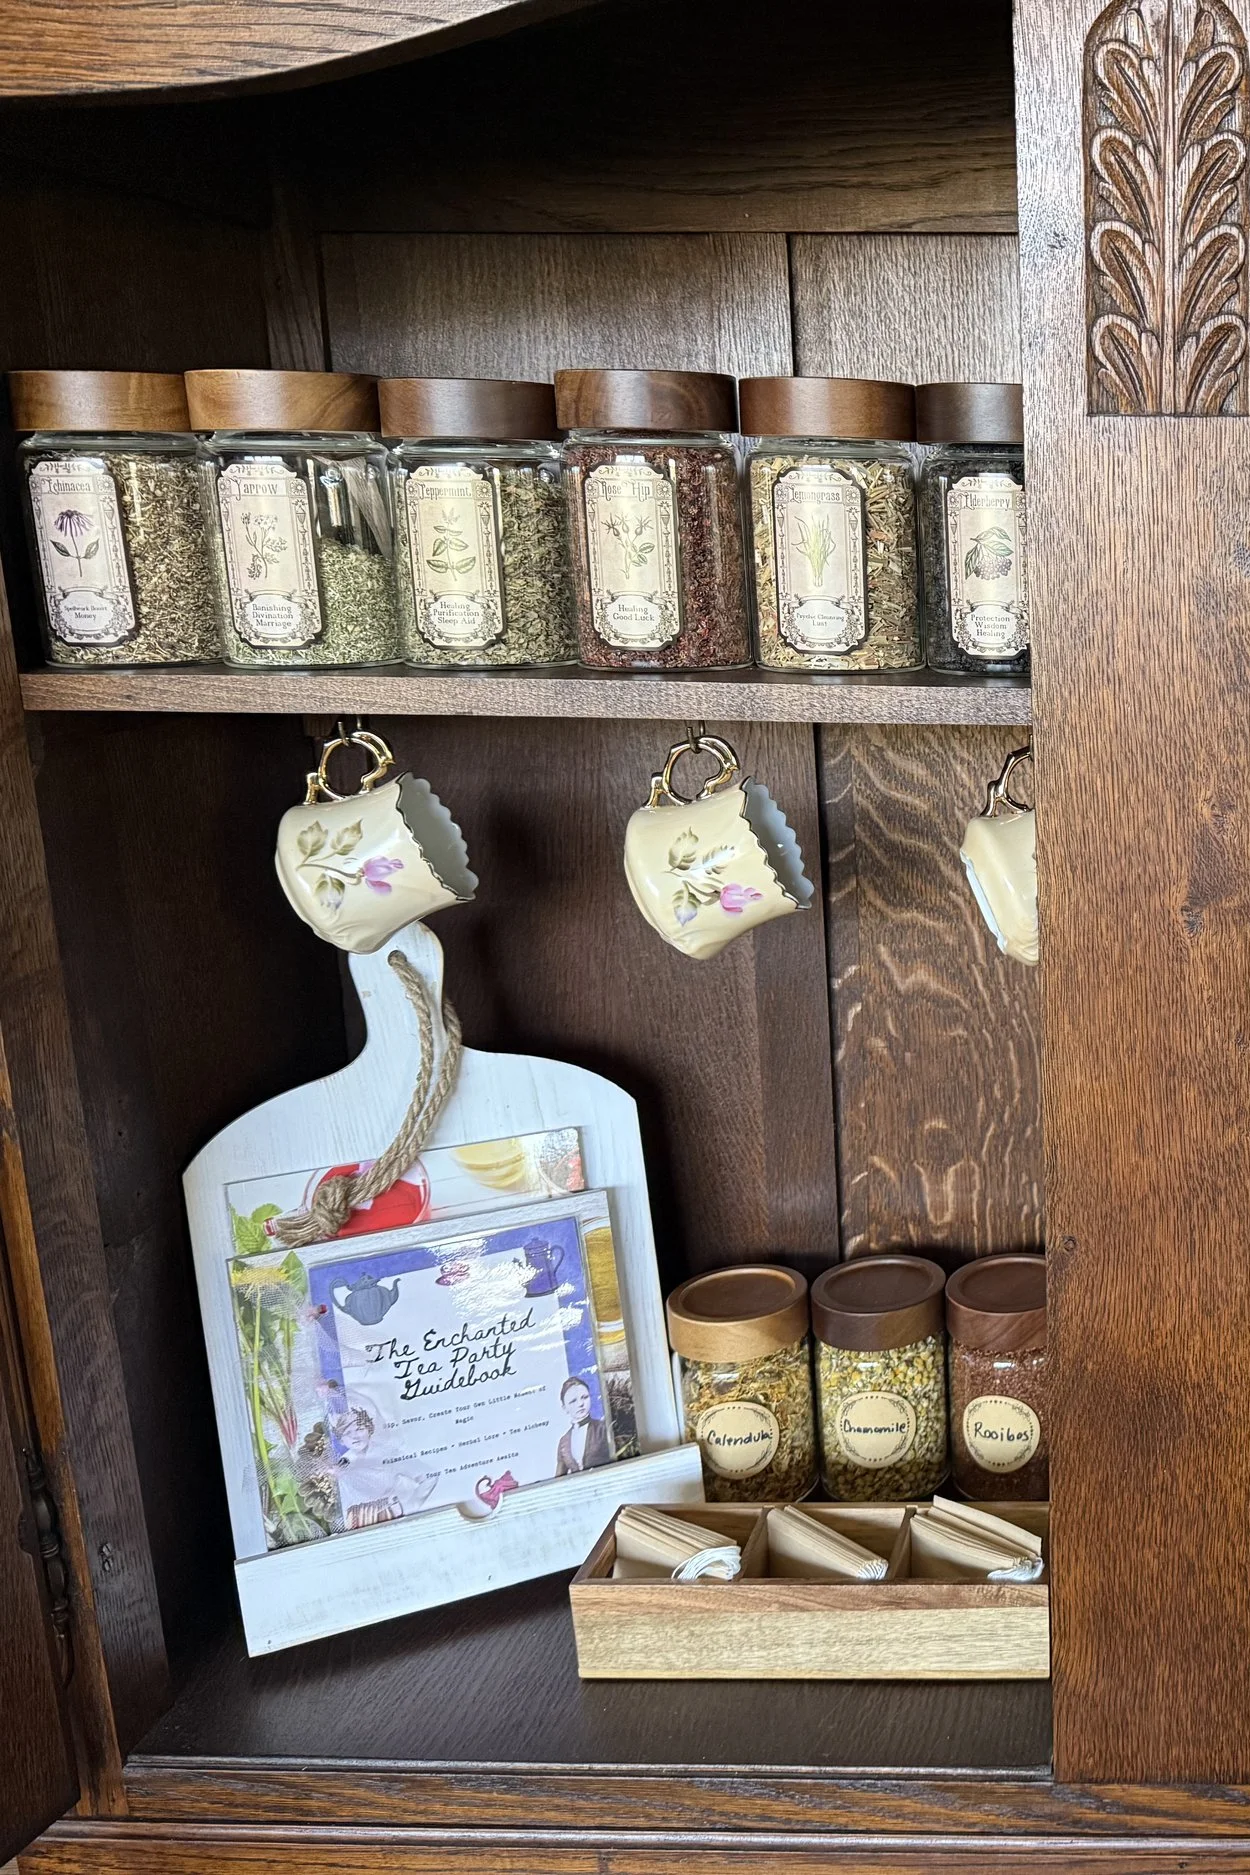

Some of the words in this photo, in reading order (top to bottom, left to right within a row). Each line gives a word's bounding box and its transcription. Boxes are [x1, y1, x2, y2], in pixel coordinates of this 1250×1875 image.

[41, 476, 91, 495] Echinacea
[227, 476, 277, 501] Yarrow
[593, 478, 622, 501] Rose
[622, 479, 651, 502] Hip
[785, 484, 840, 504] Lemongrass
[957, 491, 1010, 511] Elderberry
[252, 603, 292, 613] Banishing
[440, 601, 471, 611] Healing
[618, 604, 649, 615] Healing
[74, 612, 97, 621] Money
[252, 611, 294, 619] Divination
[433, 609, 480, 617] Purification
[612, 612, 633, 621] Good
[634, 613, 655, 621] Luck
[970, 613, 1010, 622] Protection
[255, 619, 292, 629] Marriage
[437, 616, 459, 626] Sleep
[974, 621, 1007, 630] Wisdom
[976, 629, 1006, 640] Healing
[365, 1338, 415, 1363] The
[423, 1307, 536, 1351] Enchanted
[394, 1356, 442, 1379] Tea
[450, 1337, 516, 1368] Party
[400, 1360, 517, 1400] Guidebook
[843, 1418, 907, 1435] Chamomile
[973, 1421, 1030, 1443] Rooibos
[707, 1427, 772, 1447] Calendula
